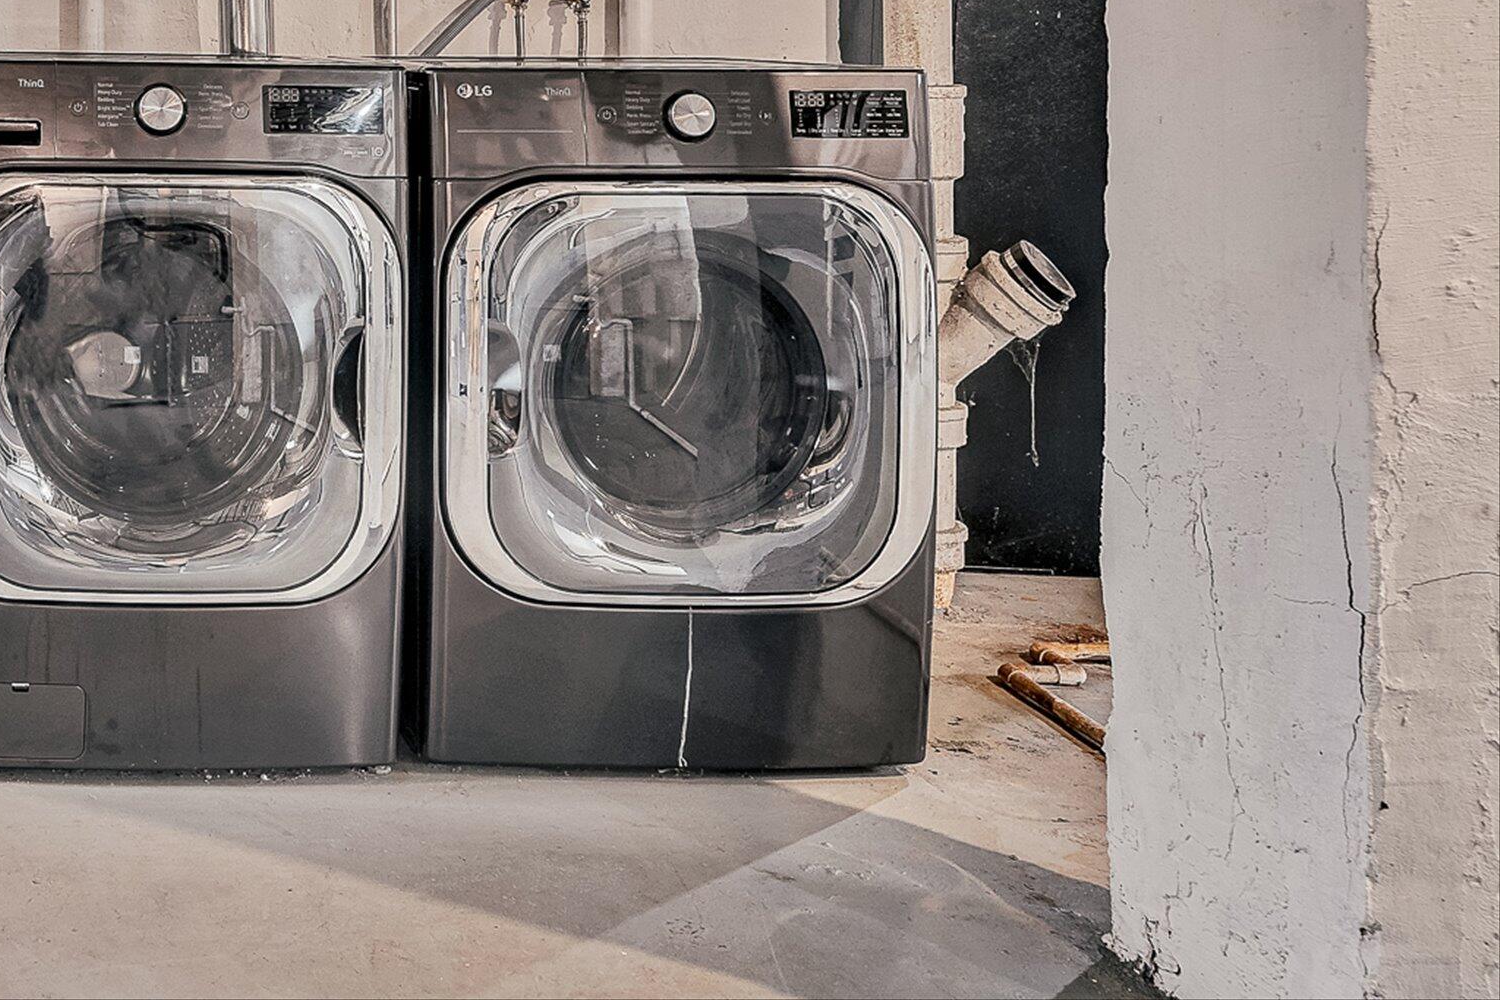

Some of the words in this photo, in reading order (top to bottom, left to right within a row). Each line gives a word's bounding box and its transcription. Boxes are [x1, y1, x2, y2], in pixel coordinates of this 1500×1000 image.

[18, 78, 45, 88] ThinQ
[474, 85, 493, 97] LG
[544, 87, 571, 97] ThinQ
